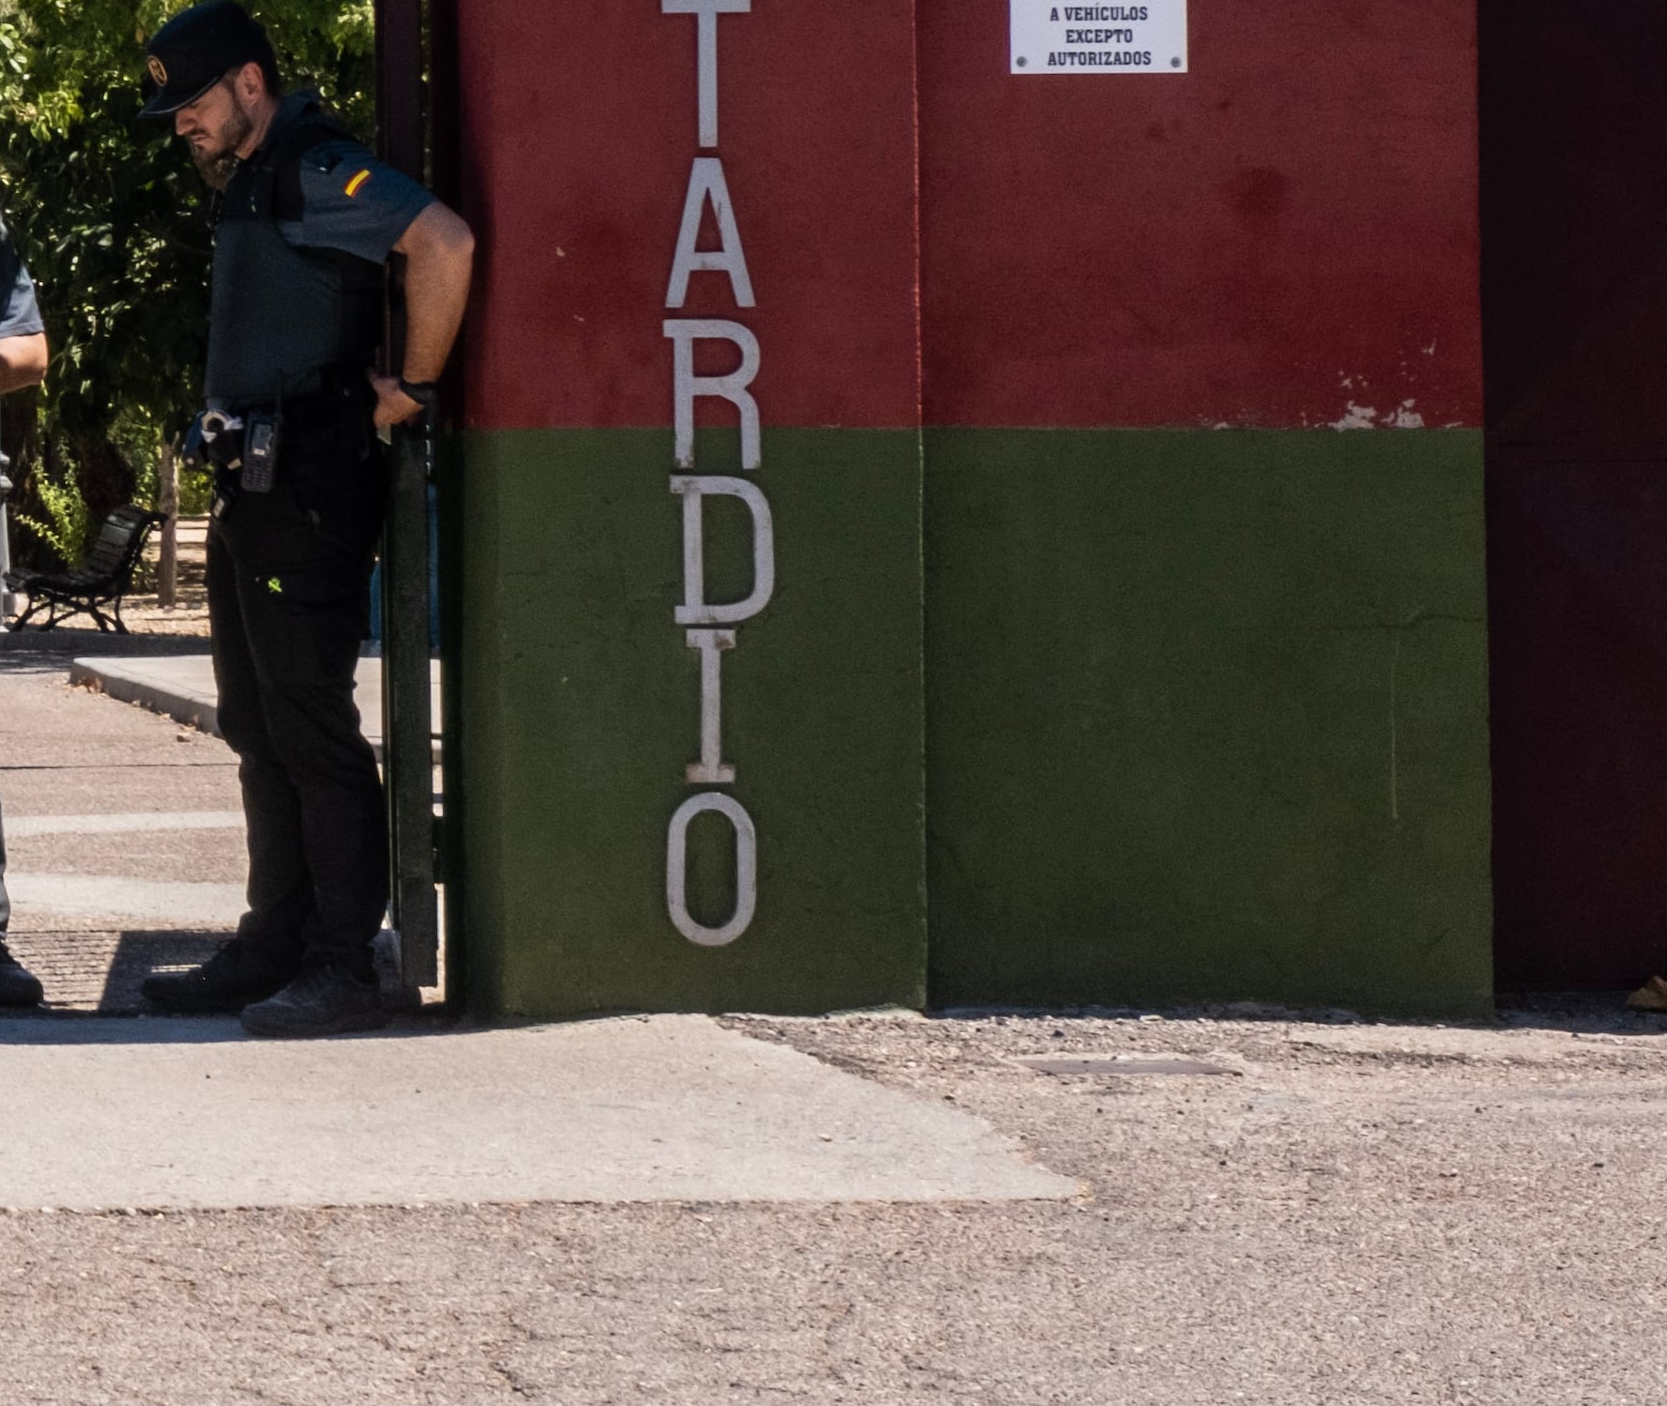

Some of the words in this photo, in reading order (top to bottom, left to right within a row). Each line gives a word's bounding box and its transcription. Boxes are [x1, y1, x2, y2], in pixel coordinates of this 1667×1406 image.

[1050, 7, 1059, 21] A
[1064, 2, 1148, 21] VEHÍCULOS
[1065, 29, 1133, 43] EXCEPTO
[1048, 51, 1152, 66] AUTORIZADOS
